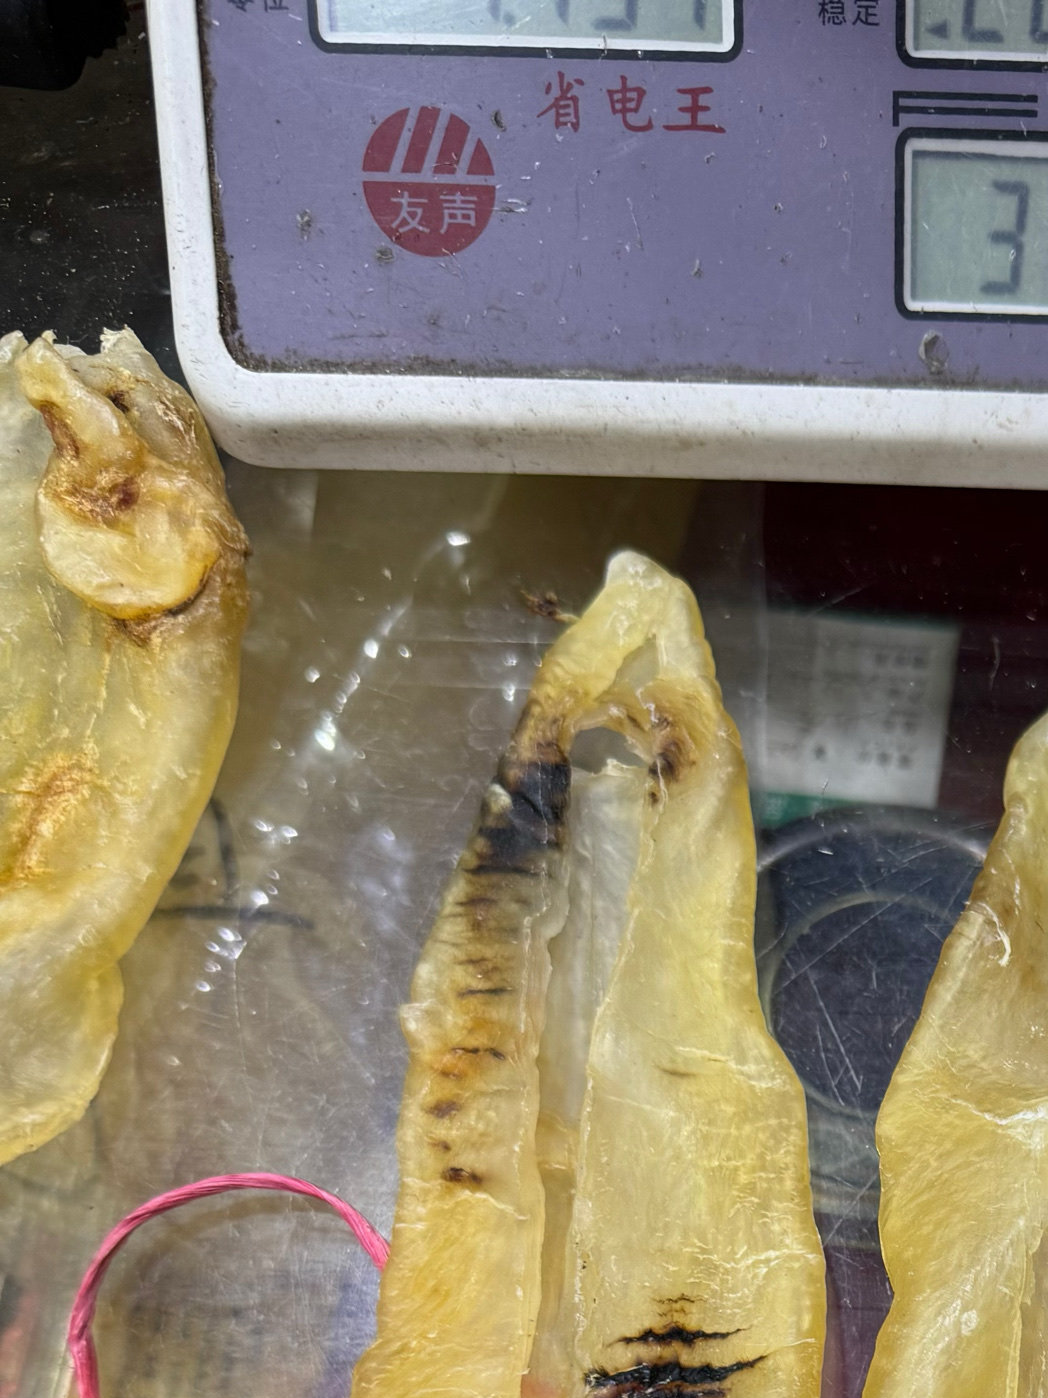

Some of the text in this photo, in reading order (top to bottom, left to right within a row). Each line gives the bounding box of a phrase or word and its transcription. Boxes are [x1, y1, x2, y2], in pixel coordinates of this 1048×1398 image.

[536, 71, 727, 135] 省电王
[390, 191, 478, 235] 友声
